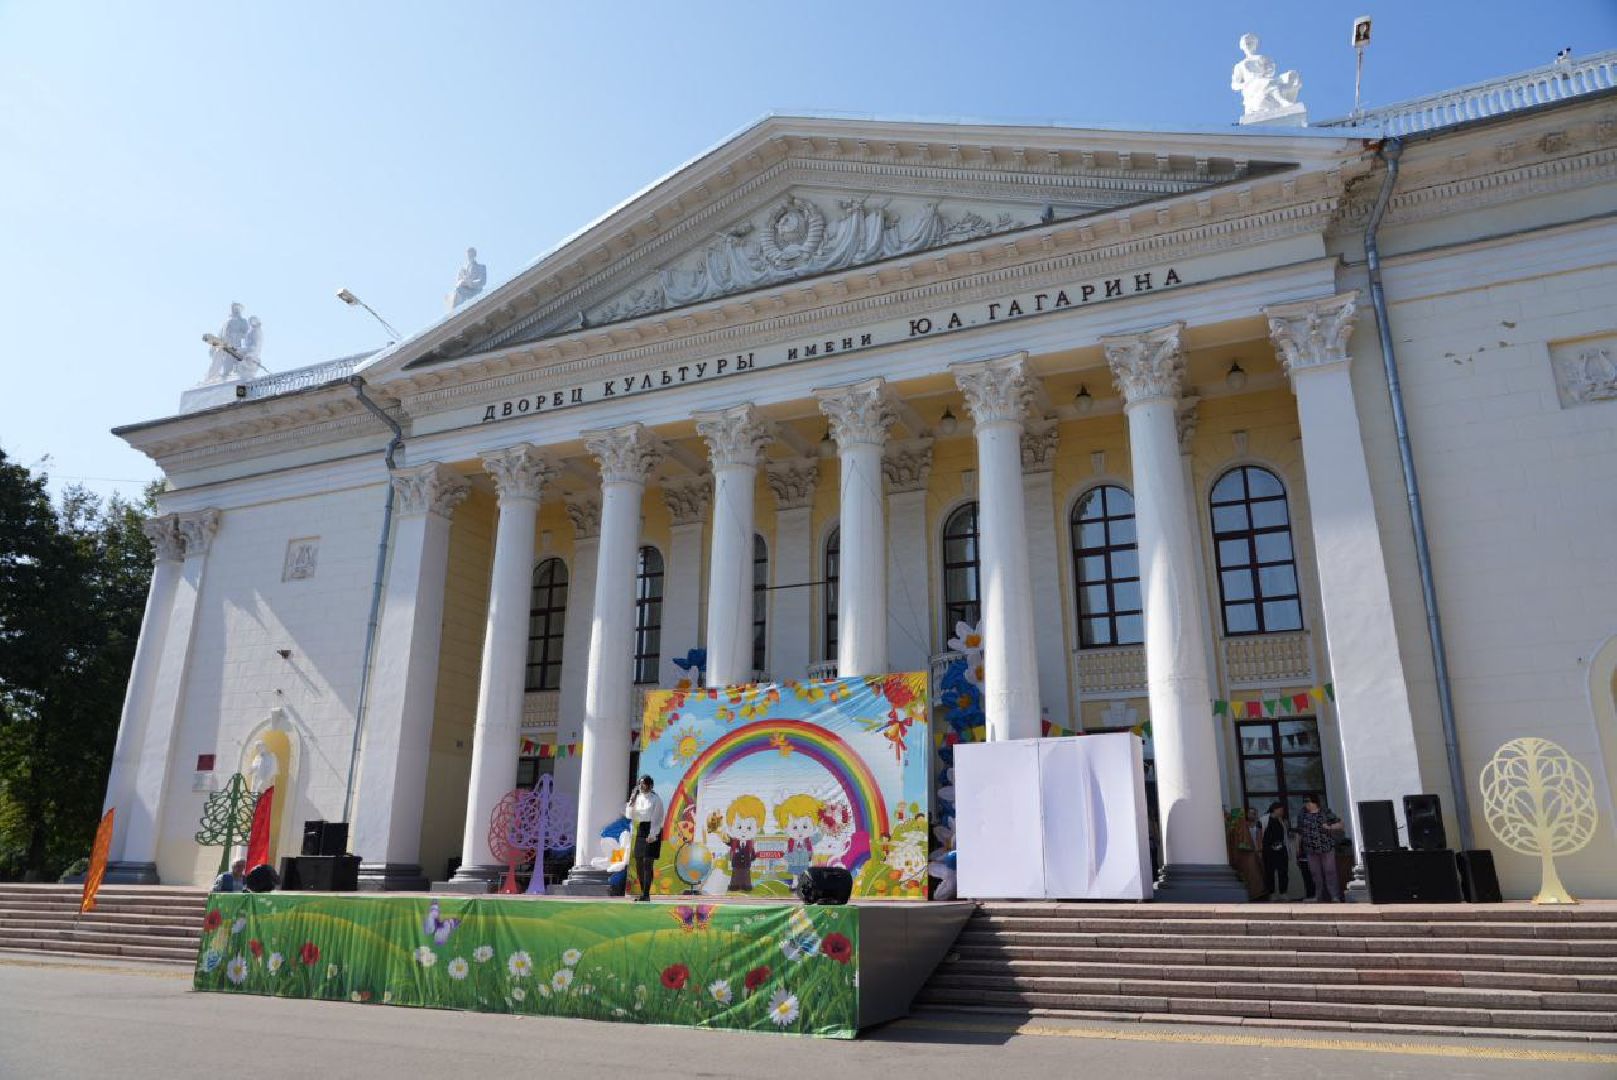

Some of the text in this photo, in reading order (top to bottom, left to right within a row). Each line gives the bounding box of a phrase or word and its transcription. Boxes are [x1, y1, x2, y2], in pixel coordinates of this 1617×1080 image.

[482, 388, 583, 422] ДВОРЕЦ
[604, 353, 755, 396] КУЛЬТУРЫ
[788, 332, 872, 360] ИМЕНИ
[989, 268, 1182, 321] ГАГАРИНА
